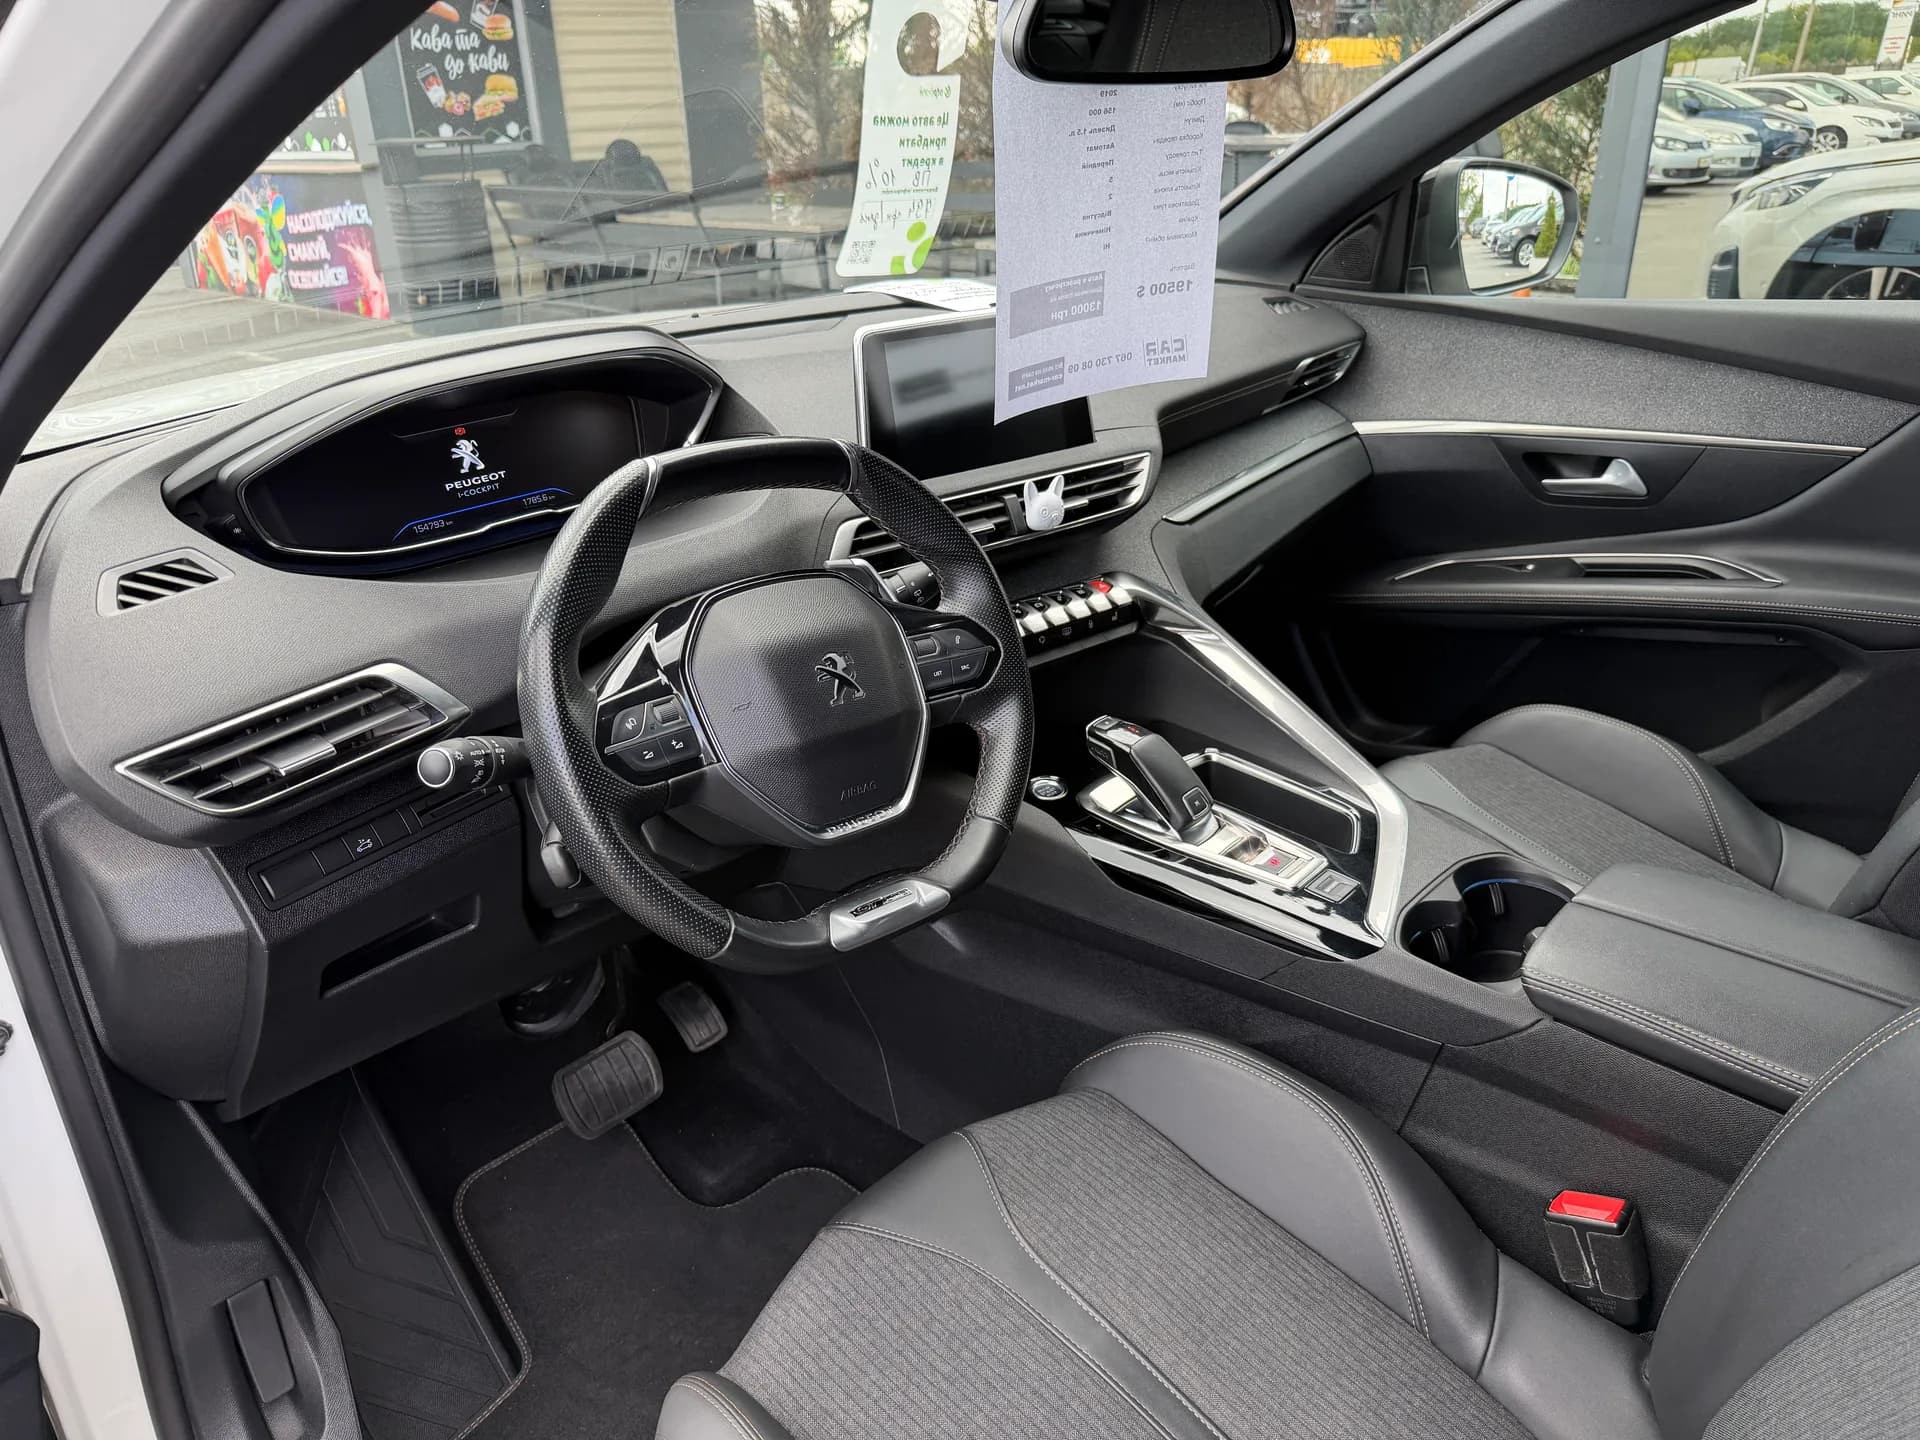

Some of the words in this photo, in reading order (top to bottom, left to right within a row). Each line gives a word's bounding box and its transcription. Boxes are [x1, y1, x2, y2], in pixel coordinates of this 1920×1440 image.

[410, 24, 453, 52] Кава
[454, 28, 481, 50] та
[444, 52, 465, 80] до
[468, 46, 509, 73] кави
[445, 471, 506, 491] PEUGEOT
[413, 519, 446, 535] 154793
[840, 780, 878, 801] AIRBAG
